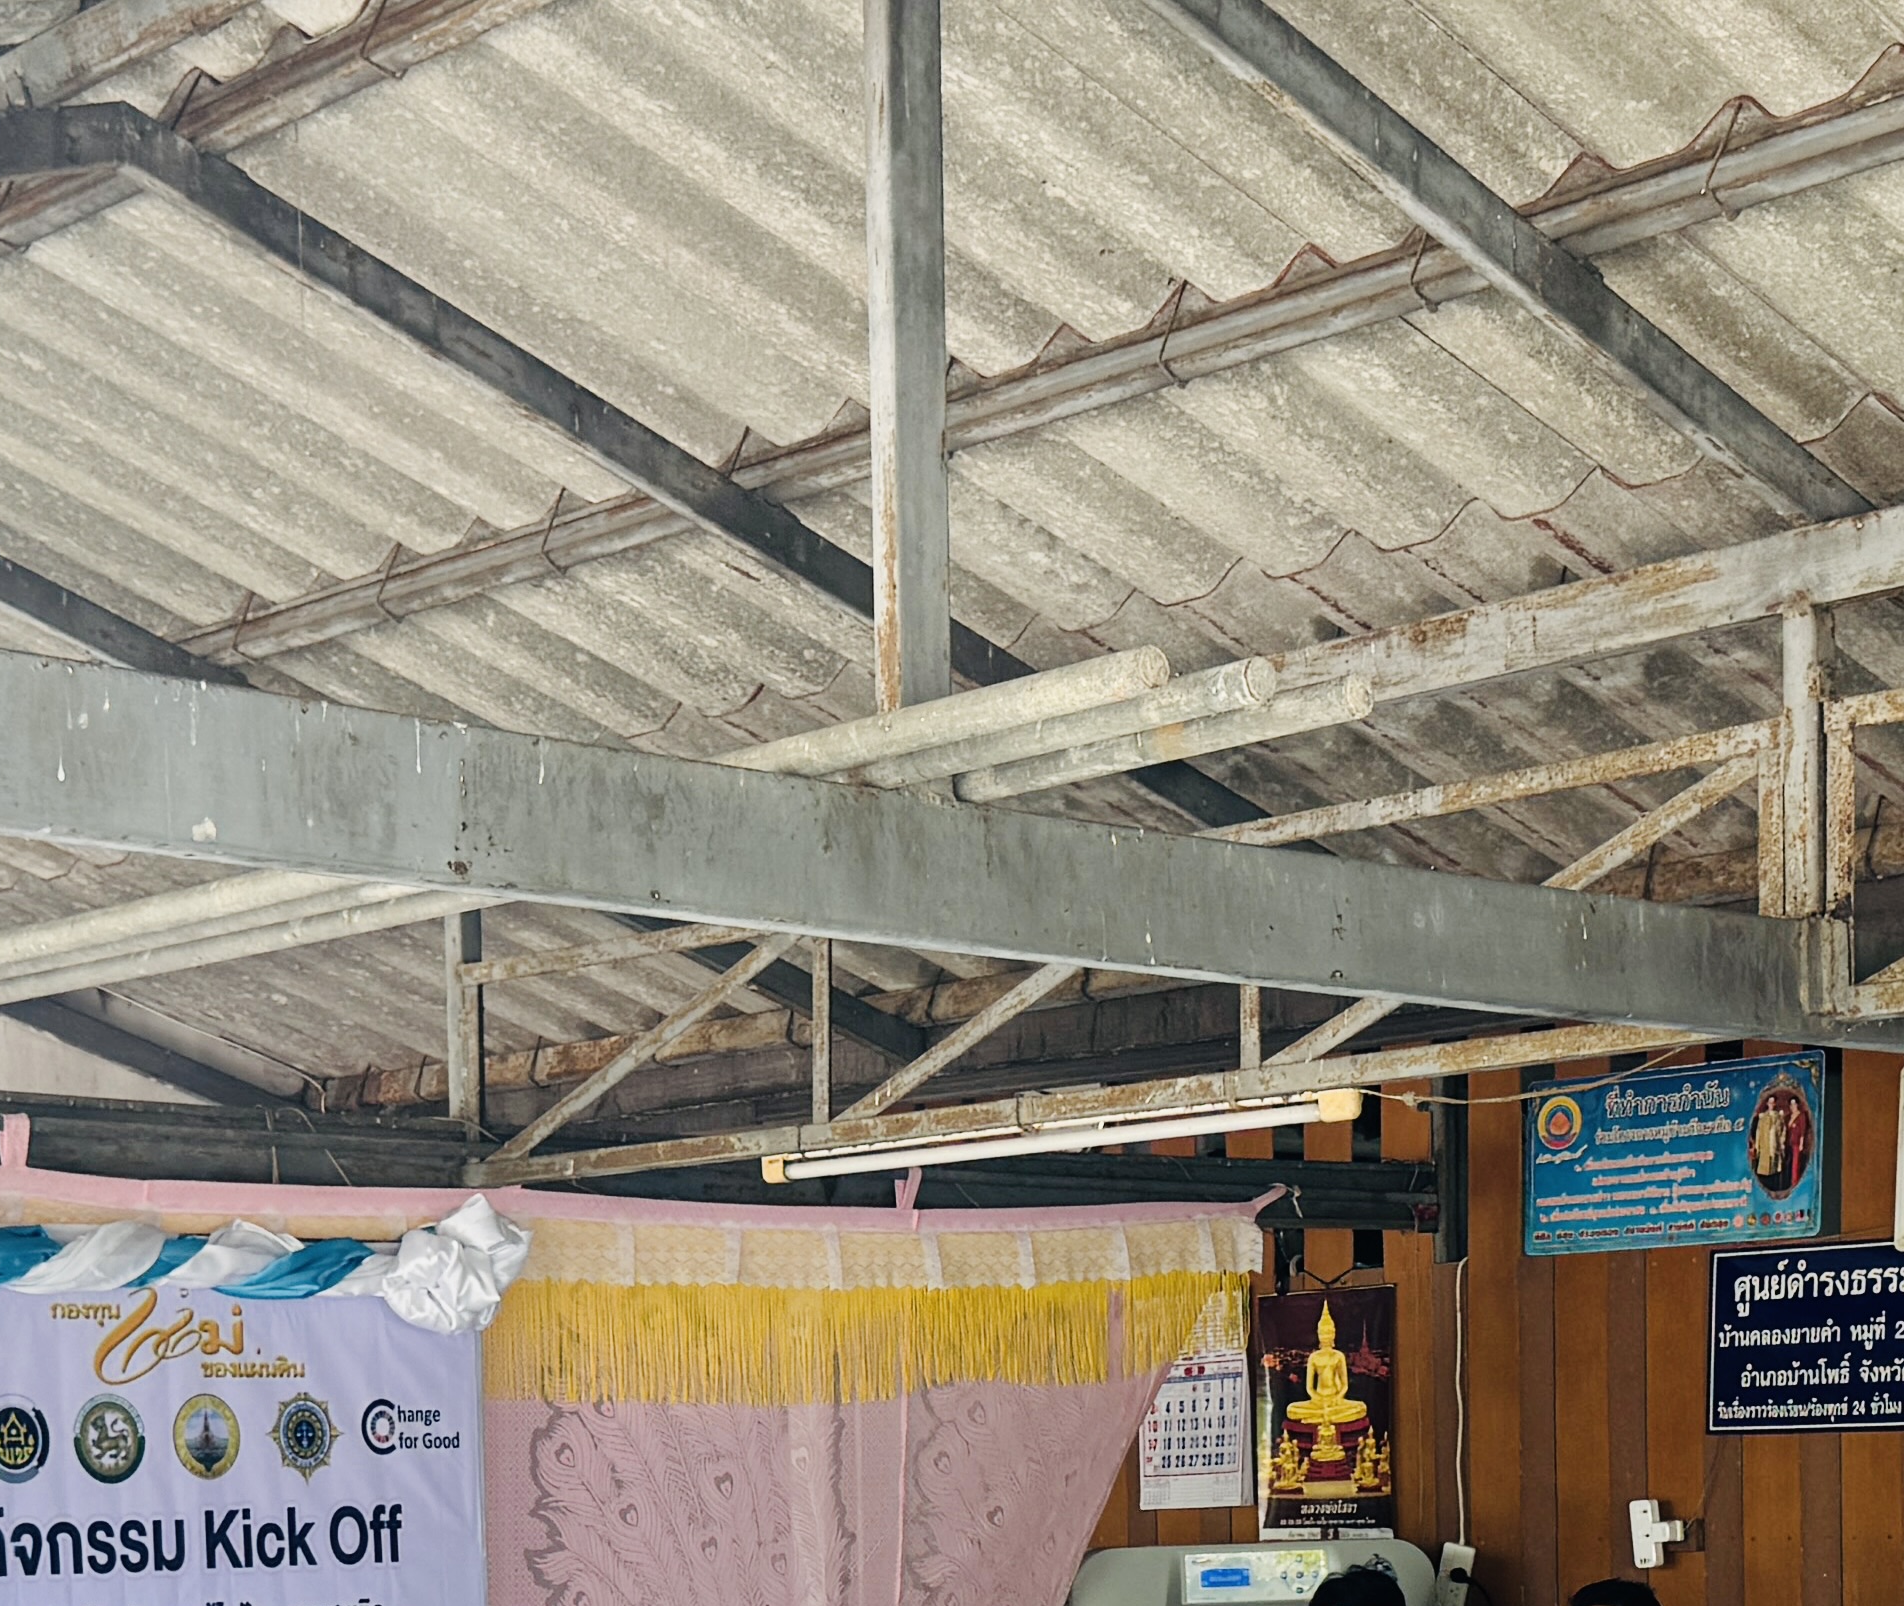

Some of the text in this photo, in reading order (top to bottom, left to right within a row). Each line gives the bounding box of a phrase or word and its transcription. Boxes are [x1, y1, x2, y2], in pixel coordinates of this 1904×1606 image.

[1718, 1318, 1841, 1348] บ้านคลองยายคำ
[1850, 1310, 1886, 1350] หมู่ที่
[1741, 1352, 1851, 1388] อำเภอบ้านโพธิ์
[1852, 1399, 1866, 1416] 24
[398, 1431, 461, 1451] for Good
[205, 1508, 319, 1571] Kick
[329, 1503, 403, 1566] Off
